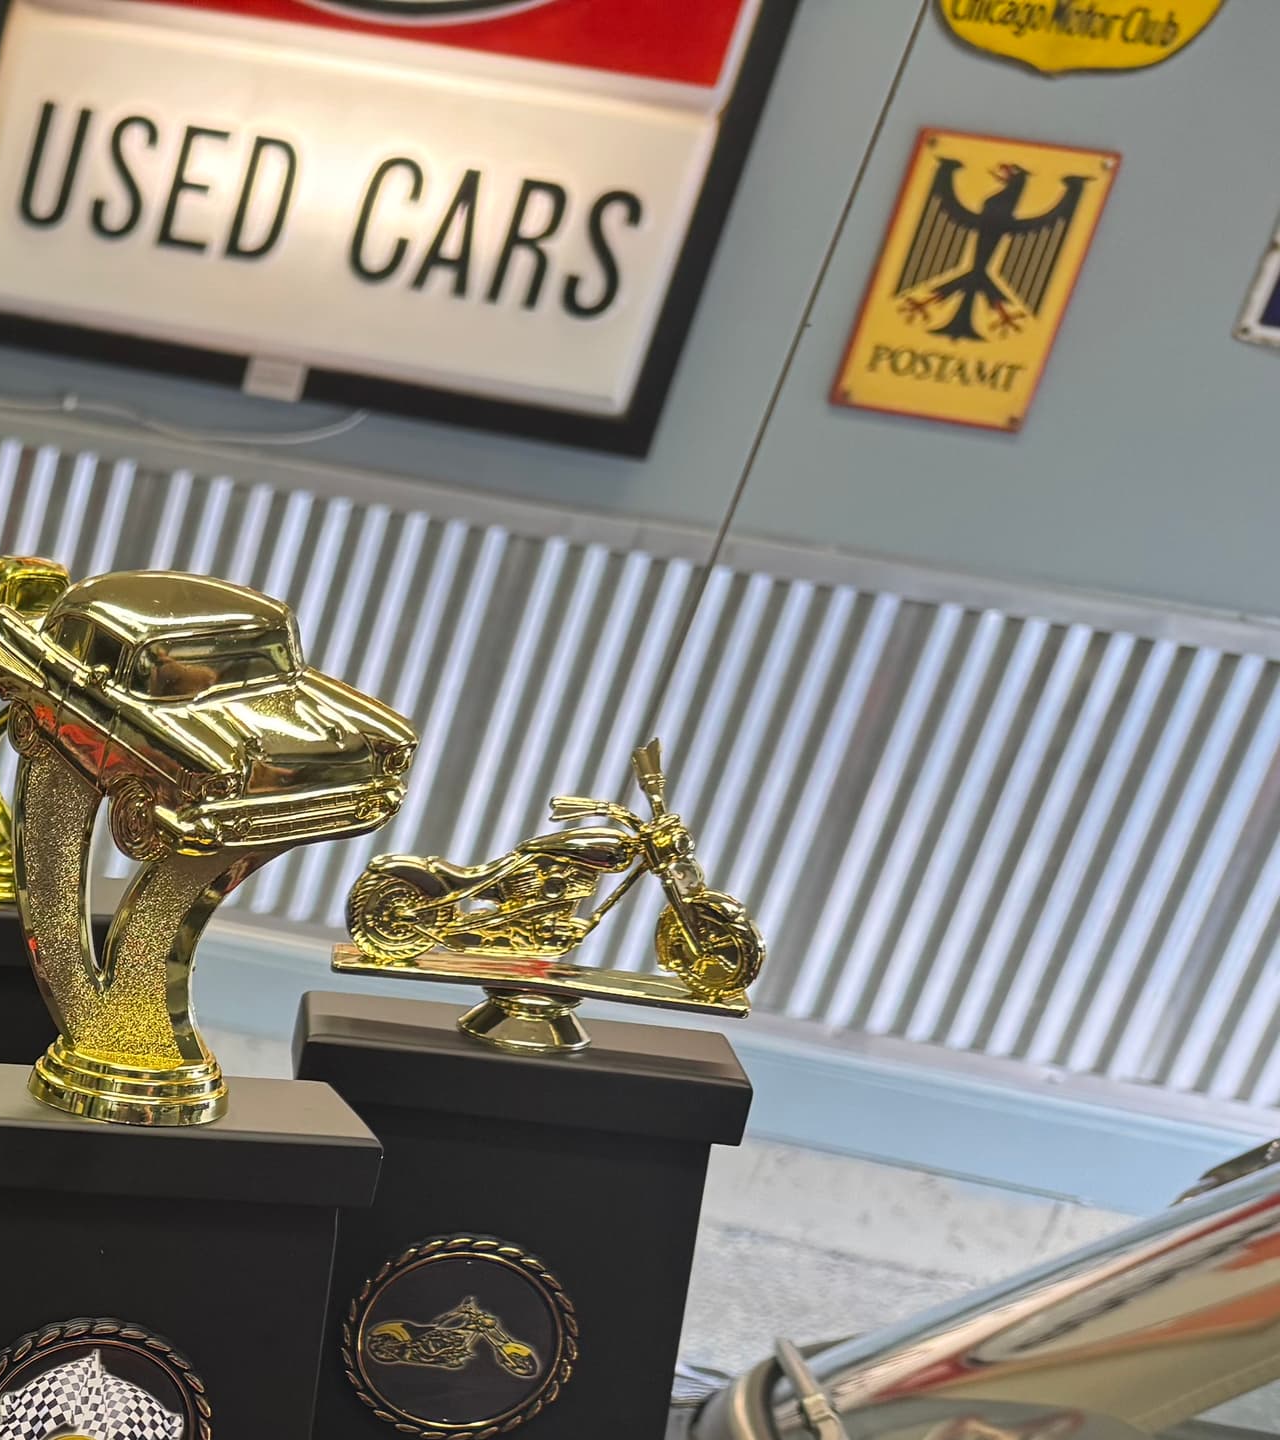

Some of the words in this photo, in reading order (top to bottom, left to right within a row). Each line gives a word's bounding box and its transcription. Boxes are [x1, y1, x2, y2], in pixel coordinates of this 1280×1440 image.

[1122, 7, 1178, 48] Club
[18, 101, 299, 262] USED
[349, 157, 643, 320] CARS
[866, 344, 1028, 393] POSTAMT
